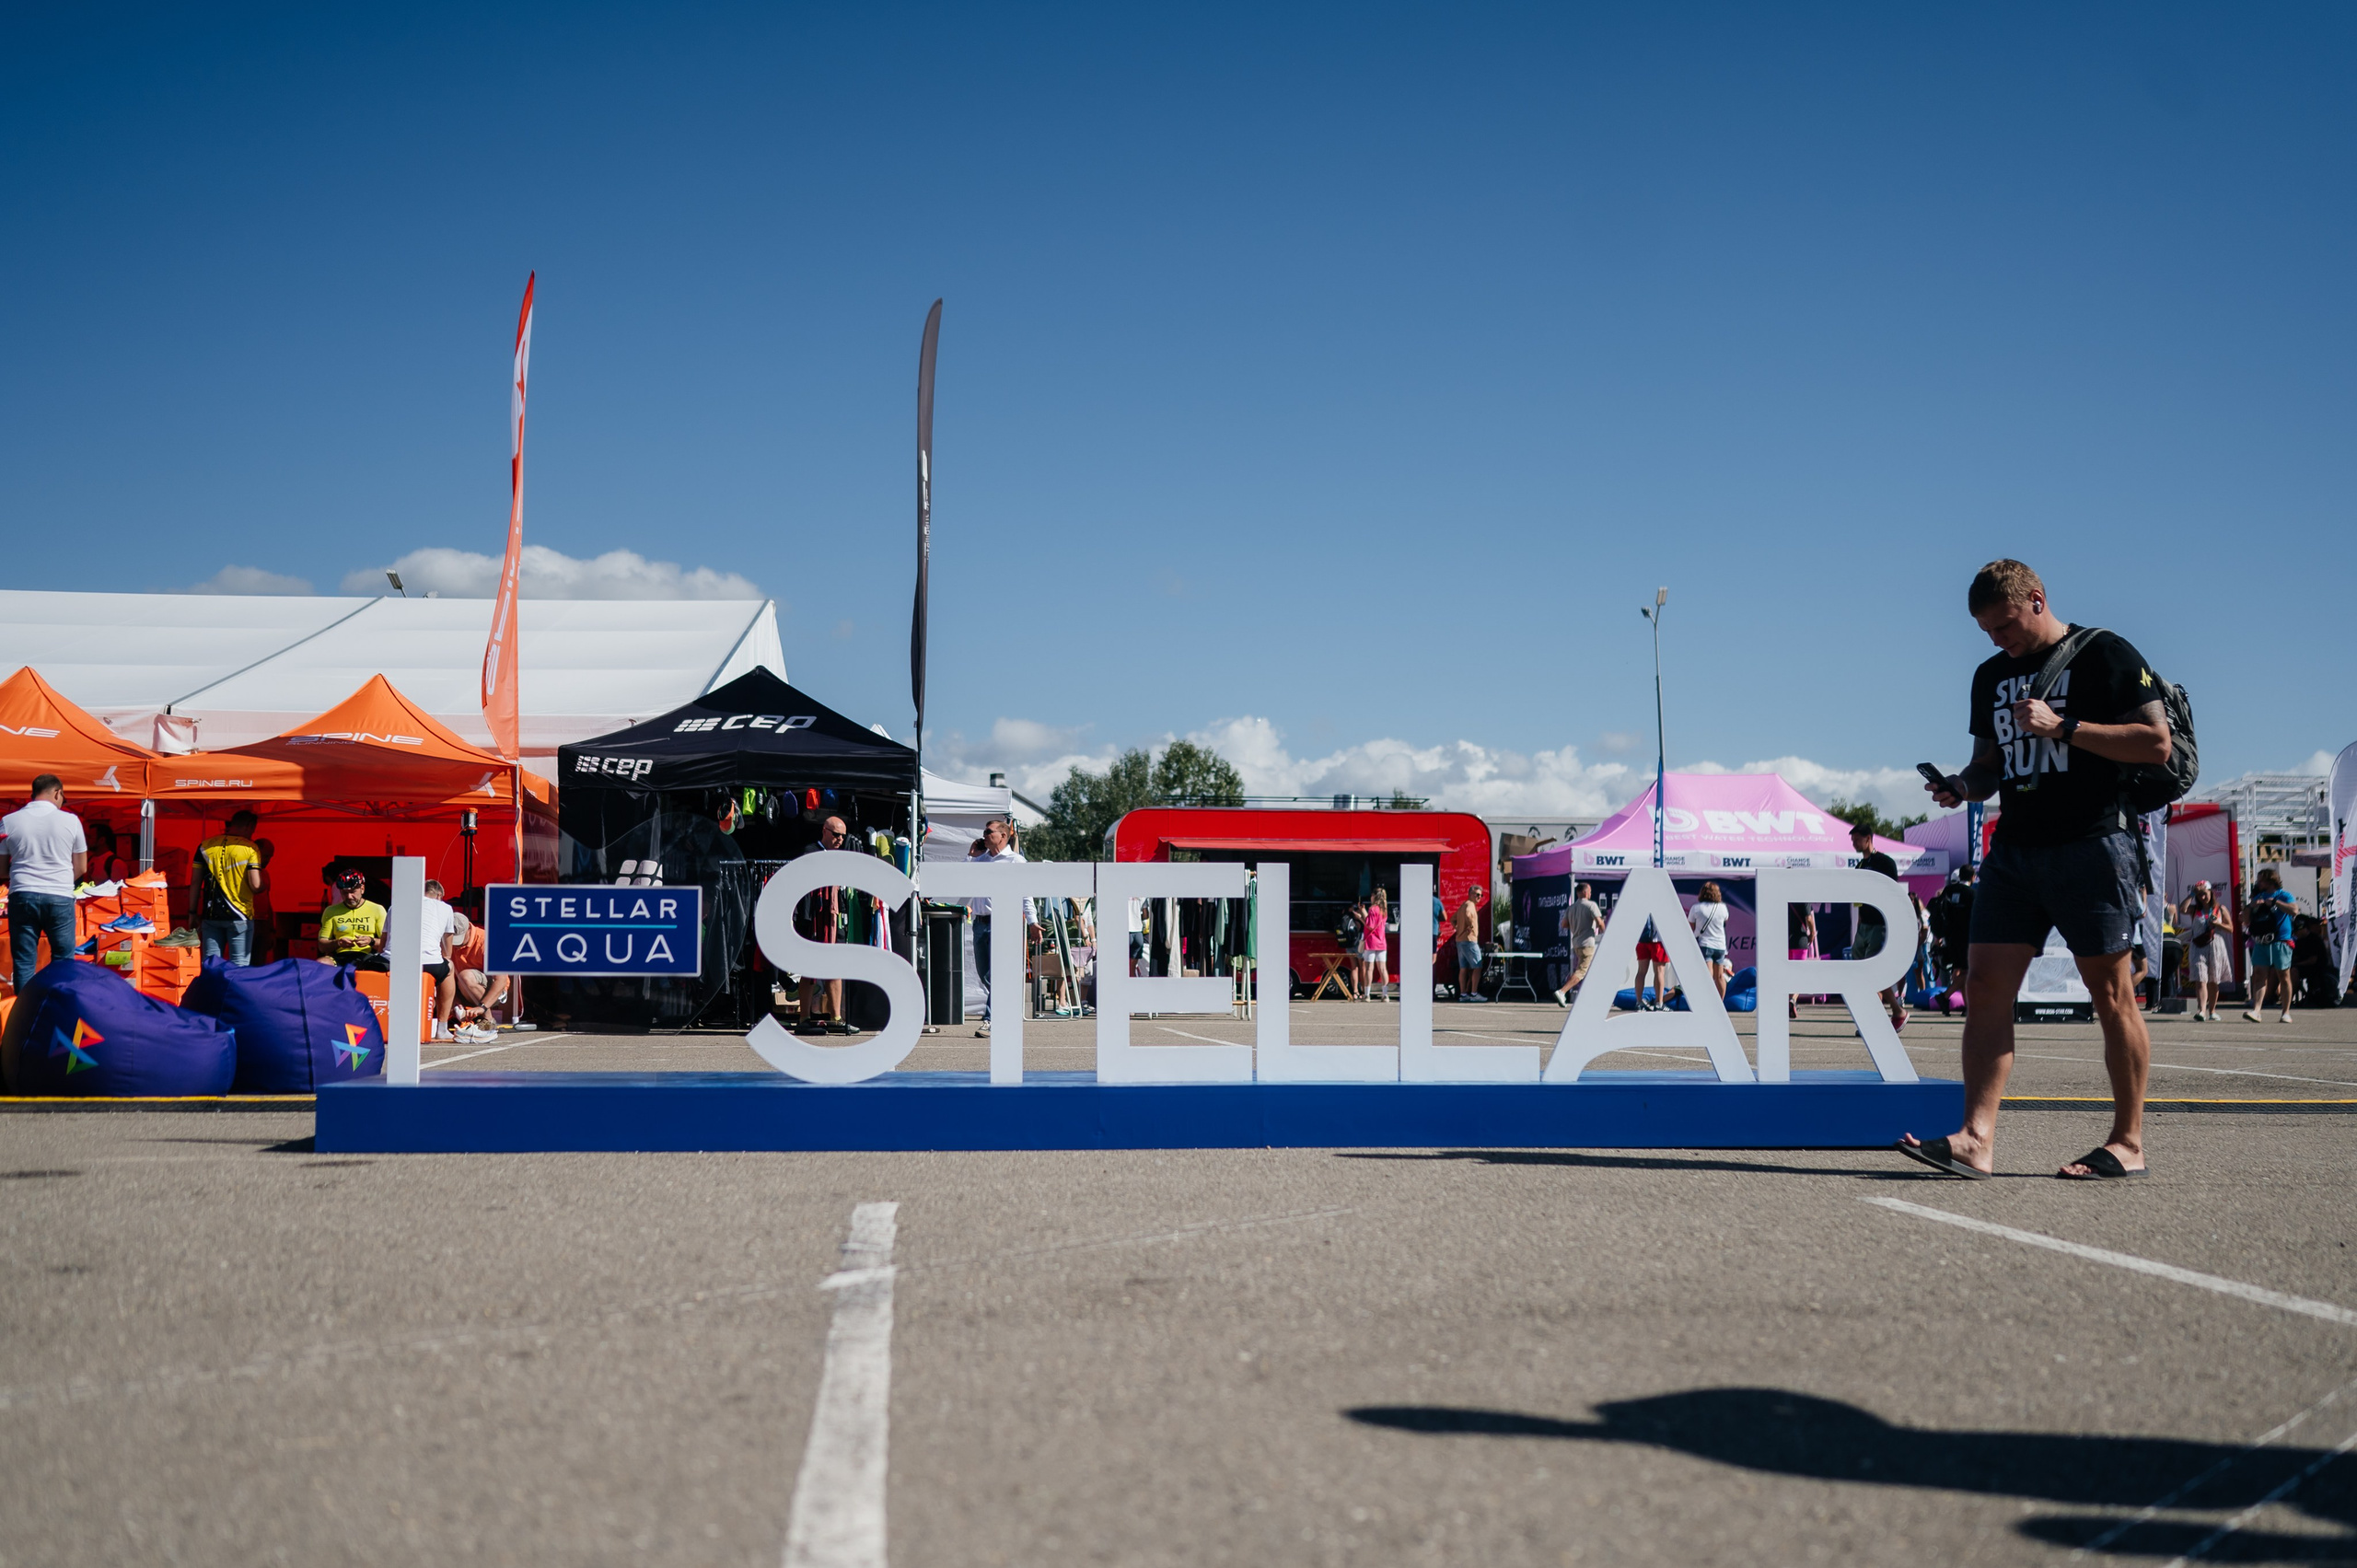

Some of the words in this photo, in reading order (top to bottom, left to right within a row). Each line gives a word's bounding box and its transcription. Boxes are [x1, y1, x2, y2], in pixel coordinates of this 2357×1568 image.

[290, 732, 424, 746] SPINE
[2001, 738, 2069, 781] RUN
[601, 757, 654, 781] cep
[175, 779, 253, 787] SPINE.RU
[1702, 809, 1826, 834] BWT
[1748, 835, 1835, 843] TECHNOLOGY
[1596, 856, 1625, 865] BWT
[1723, 857, 1751, 866] BWT
[510, 897, 678, 919] STELLAR
[337, 916, 370, 924] SAINT
[351, 923, 369, 932] TRI
[512, 932, 675, 964] AQUA
[745, 850, 1920, 1085] STELLAR
